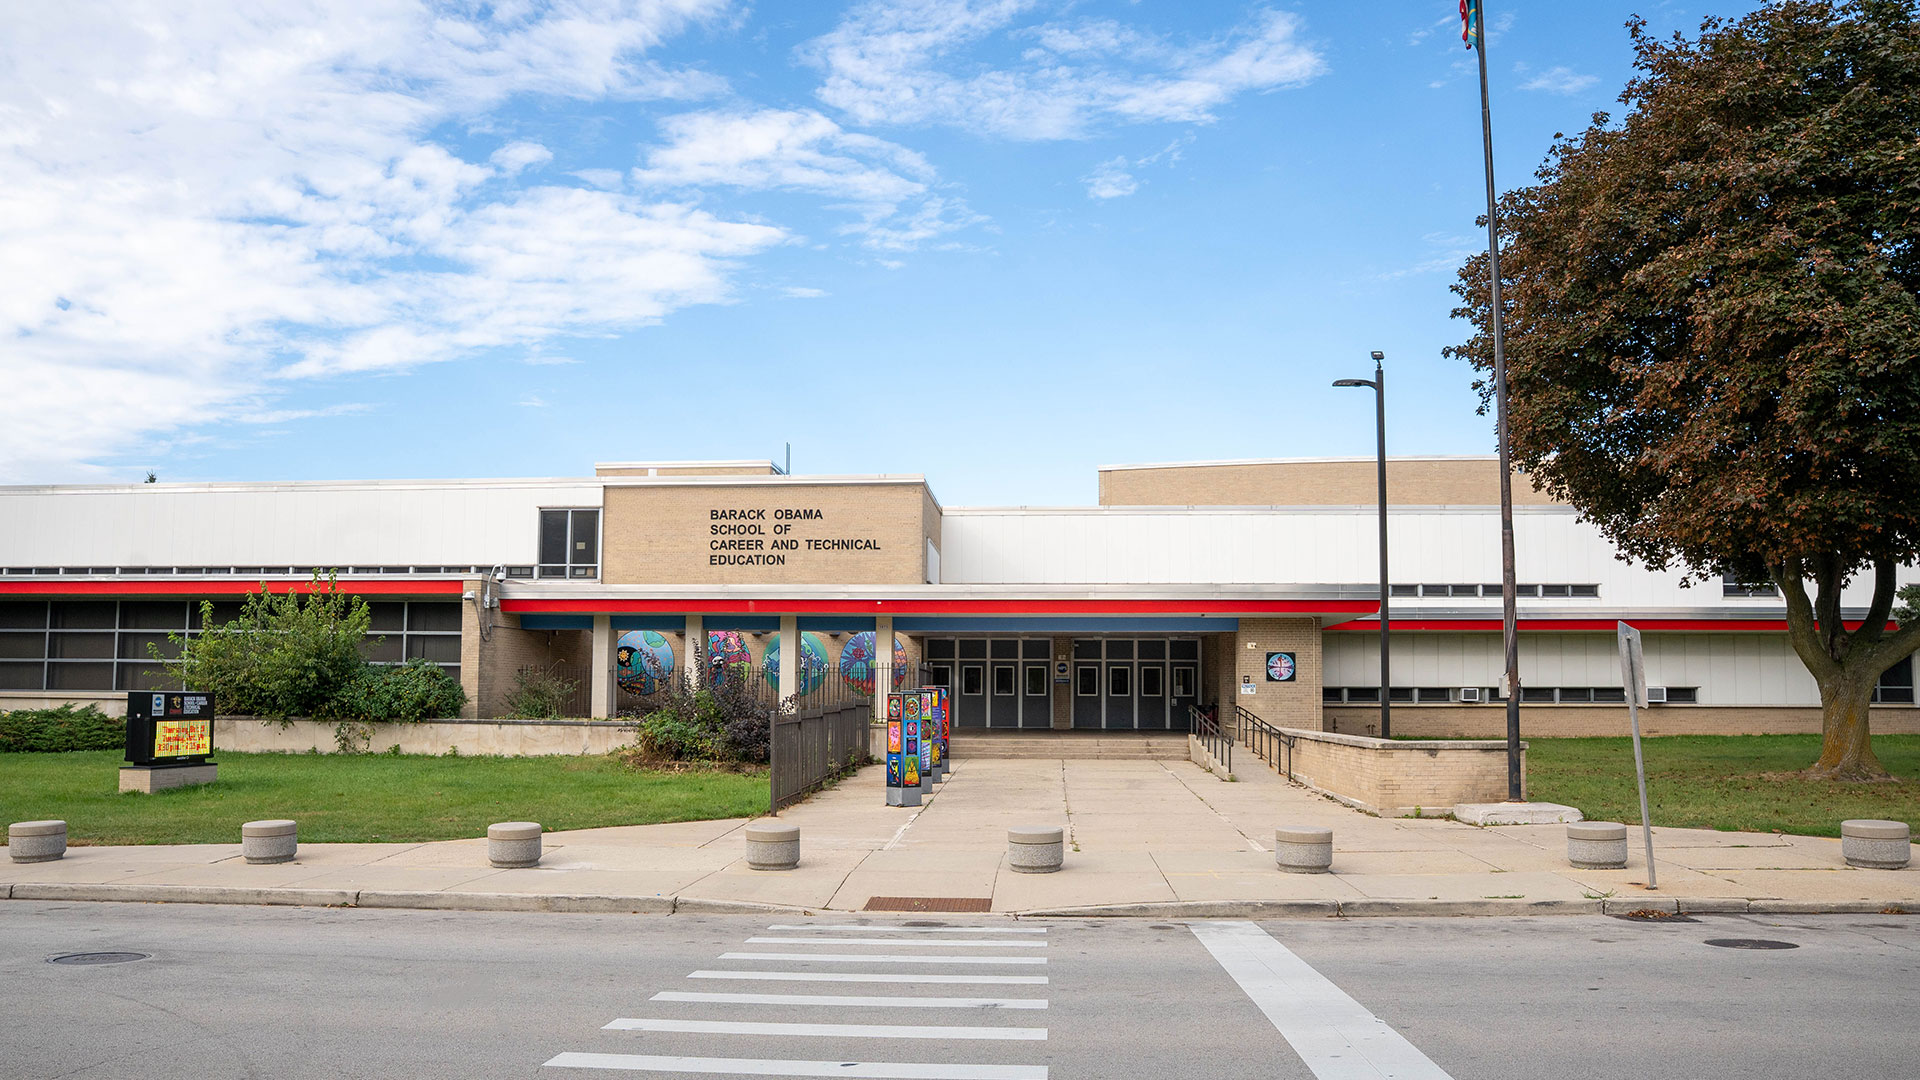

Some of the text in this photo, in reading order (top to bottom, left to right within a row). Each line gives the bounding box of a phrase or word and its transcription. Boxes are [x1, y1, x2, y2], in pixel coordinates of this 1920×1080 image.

[711, 509, 823, 520] BARACK OBAMA
[711, 524, 791, 535] SCHOOL OF
[710, 539, 880, 550] CAREER AND TECHNICAL
[710, 555, 785, 565] EDUCATION
